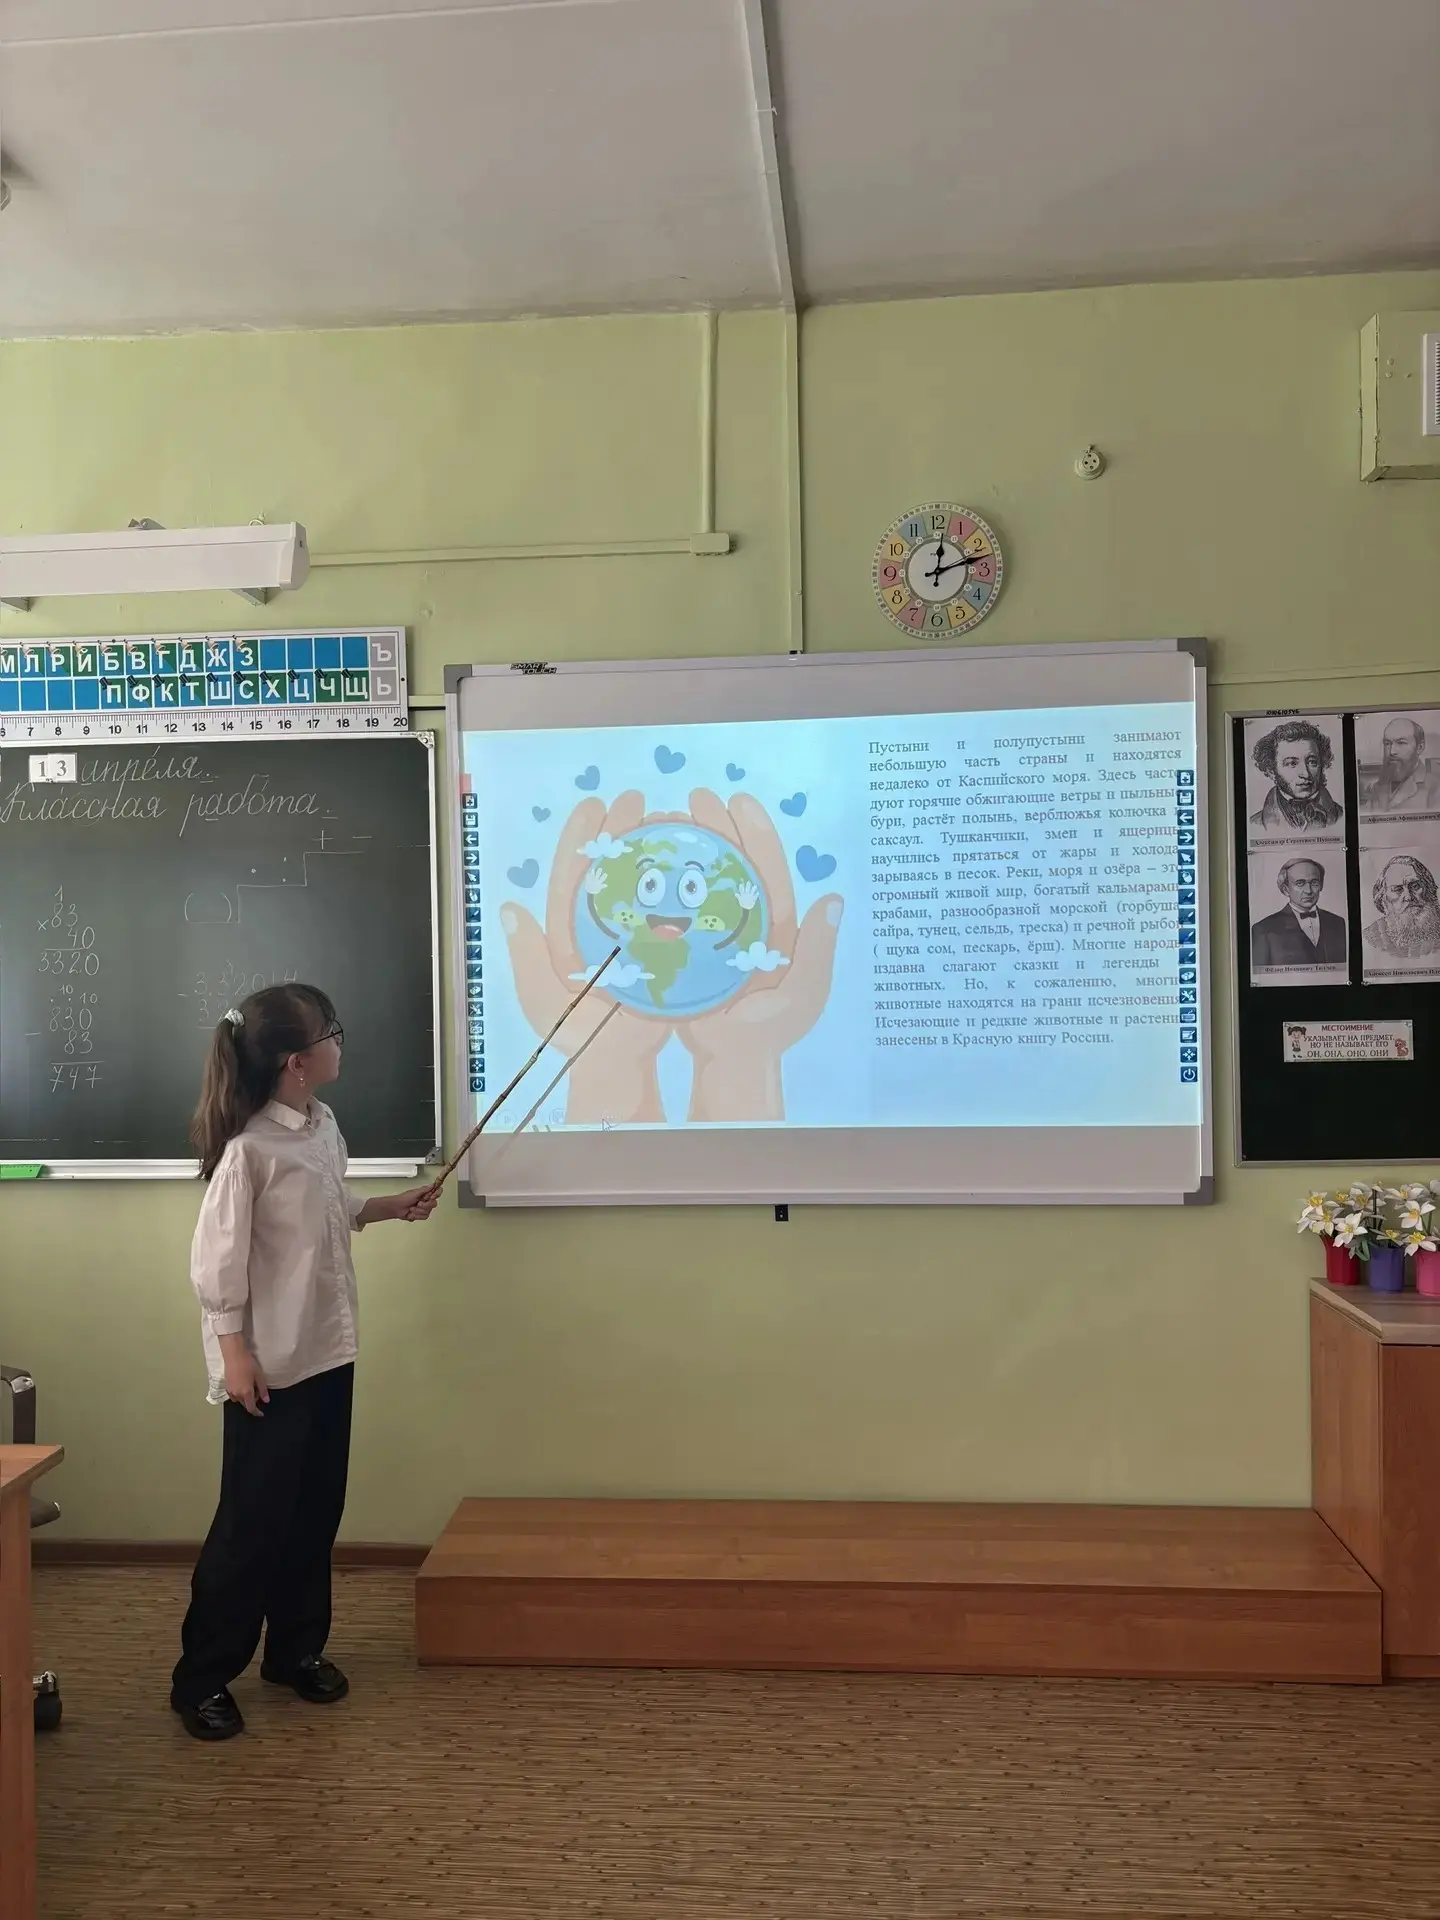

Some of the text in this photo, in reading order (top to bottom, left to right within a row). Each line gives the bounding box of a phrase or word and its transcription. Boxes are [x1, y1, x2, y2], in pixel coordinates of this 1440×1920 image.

[931, 514, 945, 530] 12
[958, 521, 963, 535] 1
[909, 523, 918, 537] 11
[890, 542, 904, 556] 10
[974, 538, 985, 552] 2
[883, 565, 897, 581] 9
[979, 562, 990, 577] 3
[891, 589, 903, 604] 8
[973, 587, 981, 601] 4
[909, 607, 919, 621] 7
[931, 613, 943, 627] 6
[955, 606, 966, 620] 5
[24, 654, 39, 673] Л
[51, 654, 65, 673] Р
[104, 652, 120, 671] Б
[131, 651, 146, 670] В
[157, 650, 170, 669] Г
[179, 649, 197, 672] Д
[207, 648, 228, 667] Ж
[240, 647, 253, 666] З
[371, 643, 392, 662] Ъ
[511, 662, 548, 670] SMART
[106, 676, 392, 703] П Ф К Т Ш С Х Ц Ч Щ Ь
[27, 717, 408, 736] 7 8 9 10 11 12 13 14 15 16 17 18 19 20
[869, 732, 1181, 755] Пустыни полупустыни занимают
[869, 751, 1181, 771] небольшую часть страны находятся
[870, 769, 1136, 790] недалеко от Каспийского моря. Здесь
[870, 792, 1101, 811] дуют горячие обжигающие ветры
[870, 809, 1166, 830] бури, растёт полынь, верблюжья колючка
[871, 834, 923, 847] саксаул.
[940, 831, 1028, 845] Тушканчики,
[1045, 830, 1078, 840] змеи
[871, 853, 940, 866] научились
[952, 850, 1019, 864] прятаться
[1032, 849, 1047, 859] от
[1060, 848, 1096, 860] жары
[872, 871, 938, 884] зарываясь
[958, 870, 999, 879] песок.
[1007, 866, 1042, 879] Реки,
[1049, 867, 1082, 880] моря
[1104, 863, 1140, 878] озёра
[872, 886, 939, 902] огромный
[946, 885, 988, 898] живой
[996, 887, 1027, 899] мир,
[1034, 882, 1089, 895] богатый
[872, 906, 932, 921] крабами,
[941, 903, 1040, 920] разнообразной
[1050, 901, 1106, 917] морской
[873, 918, 1135, 938] сайра, тунец, сельдь, треска) речной
[886, 944, 919, 957] щука
[927, 944, 956, 954] сом,
[964, 943, 1020, 955] пескарь,
[1028, 939, 1064, 954] ёрш).
[1072, 939, 1126, 951] Многие
[874, 959, 1159, 973] издавна слагают сказки легенды
[874, 977, 1116, 991] животных. Но, сожалению,
[875, 999, 941, 1009] животные
[948, 998, 1013, 1009] находятся
[1021, 998, 1036, 1007] на
[1042, 998, 1081, 1010] грани
[875, 1016, 1103, 1029] Исчезающие редкие животные
[1321, 1023, 1374, 1032] МЕСТОИМЕНИЕ
[876, 1030, 1113, 1047] занесены Красную книгу России.
[1303, 1034, 1346, 1042] УКАЗЫВАЕТ
[1334, 1040, 1374, 1048] НАЗЫВАЕТ
[1369, 1049, 1389, 1057] ОНИ
